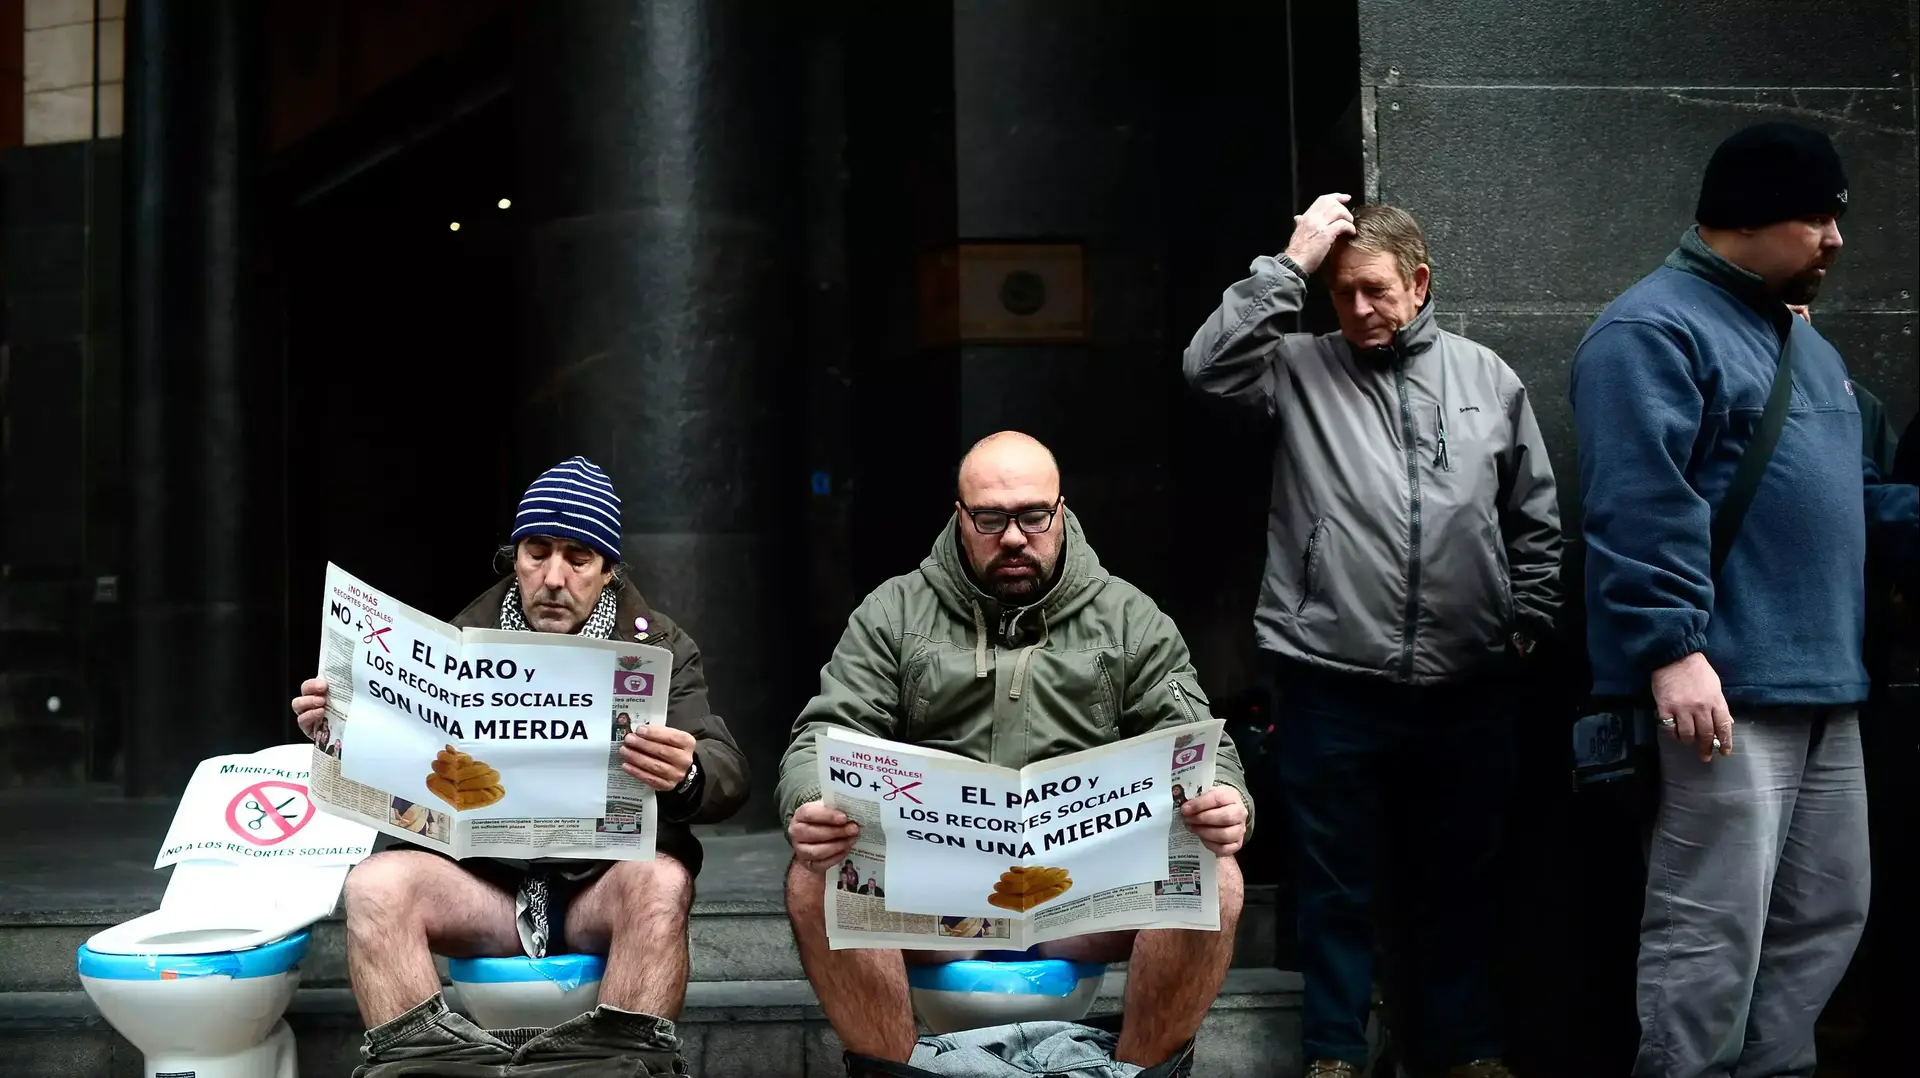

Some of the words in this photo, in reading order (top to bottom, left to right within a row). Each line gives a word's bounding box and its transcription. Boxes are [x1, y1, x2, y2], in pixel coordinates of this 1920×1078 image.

[334, 587, 361, 607] RECORTES
[363, 592, 378, 606] MÁS
[331, 599, 351, 625] NO
[412, 639, 436, 669] EL
[444, 654, 518, 681] PARO
[523, 668, 536, 682] y
[366, 650, 394, 676] LOS
[398, 667, 485, 708] RECORTES
[491, 692, 593, 707] SOCIALES
[368, 680, 412, 714] SON
[418, 703, 464, 739] UNA
[474, 719, 588, 740] MIERDA
[830, 755, 873, 770] RECORTES
[876, 766, 922, 779] SOCIALES!
[852, 752, 871, 761] ¡NO
[875, 756, 898, 766] MÁS
[830, 766, 861, 788] NO
[962, 786, 995, 806] EL
[1006, 775, 1081, 809] PARO
[1088, 776, 1099, 789] y
[900, 807, 939, 823] LOS
[946, 811, 1051, 834] RECORTES
[1057, 777, 1153, 818] SOCIALES
[906, 830, 965, 848] SON
[976, 839, 1035, 859] UNA
[1043, 801, 1152, 851] MIERDA
[197, 841, 222, 849] LOS
[227, 843, 295, 857] RECORTES
[300, 847, 367, 856] SOCIALES!
